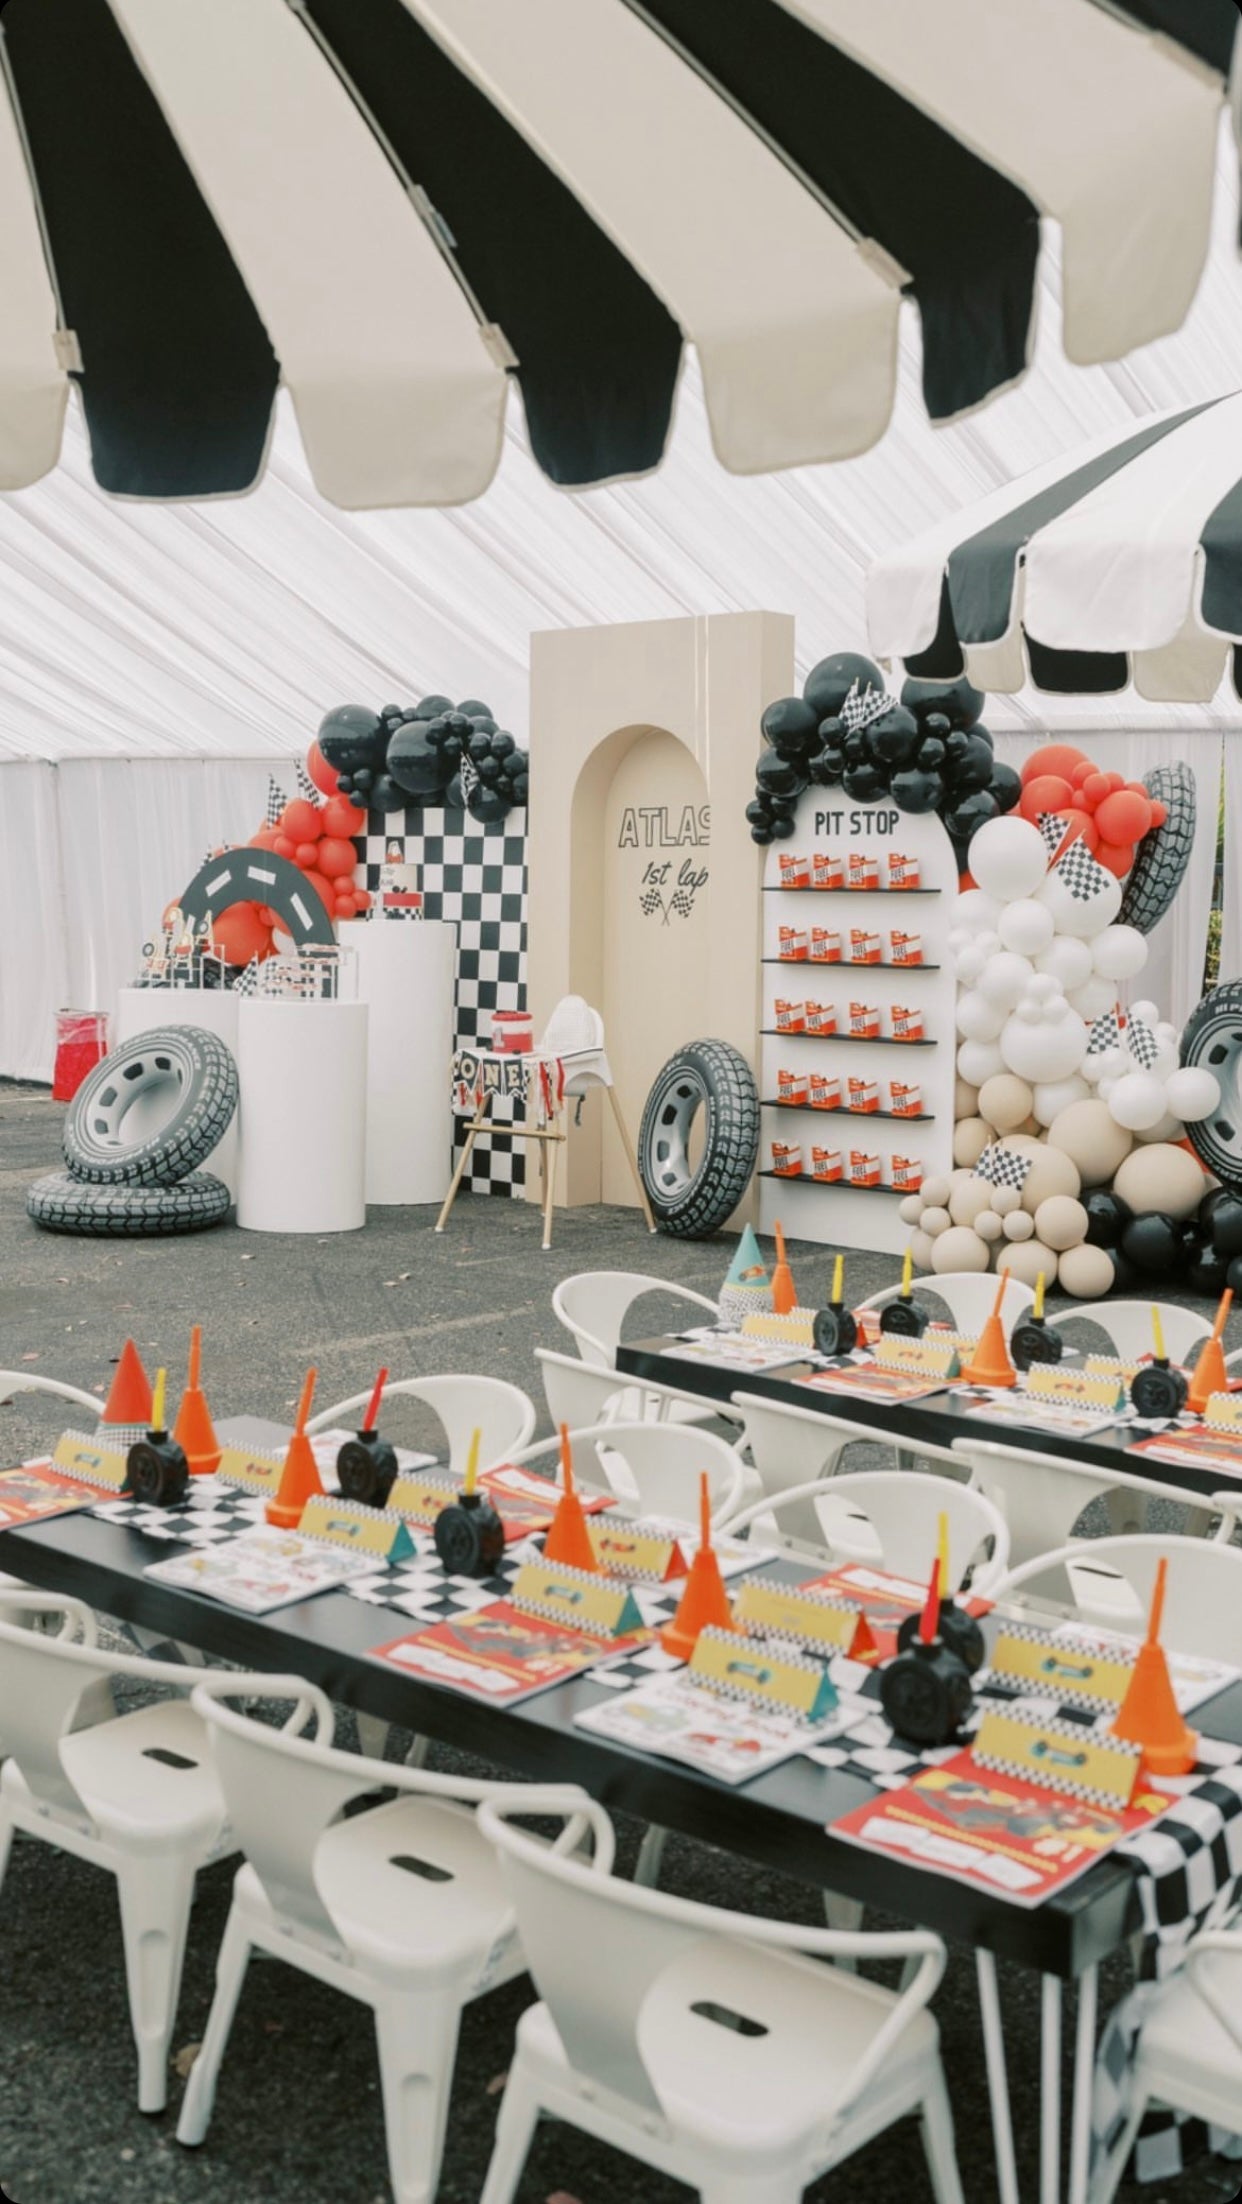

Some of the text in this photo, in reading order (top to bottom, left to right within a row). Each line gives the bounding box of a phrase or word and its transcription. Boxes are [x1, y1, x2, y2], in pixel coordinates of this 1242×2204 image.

[815, 810, 900, 836] PIT STOP
[641, 858, 709, 897] 1st lap
[461, 1058, 521, 1087] ONE
